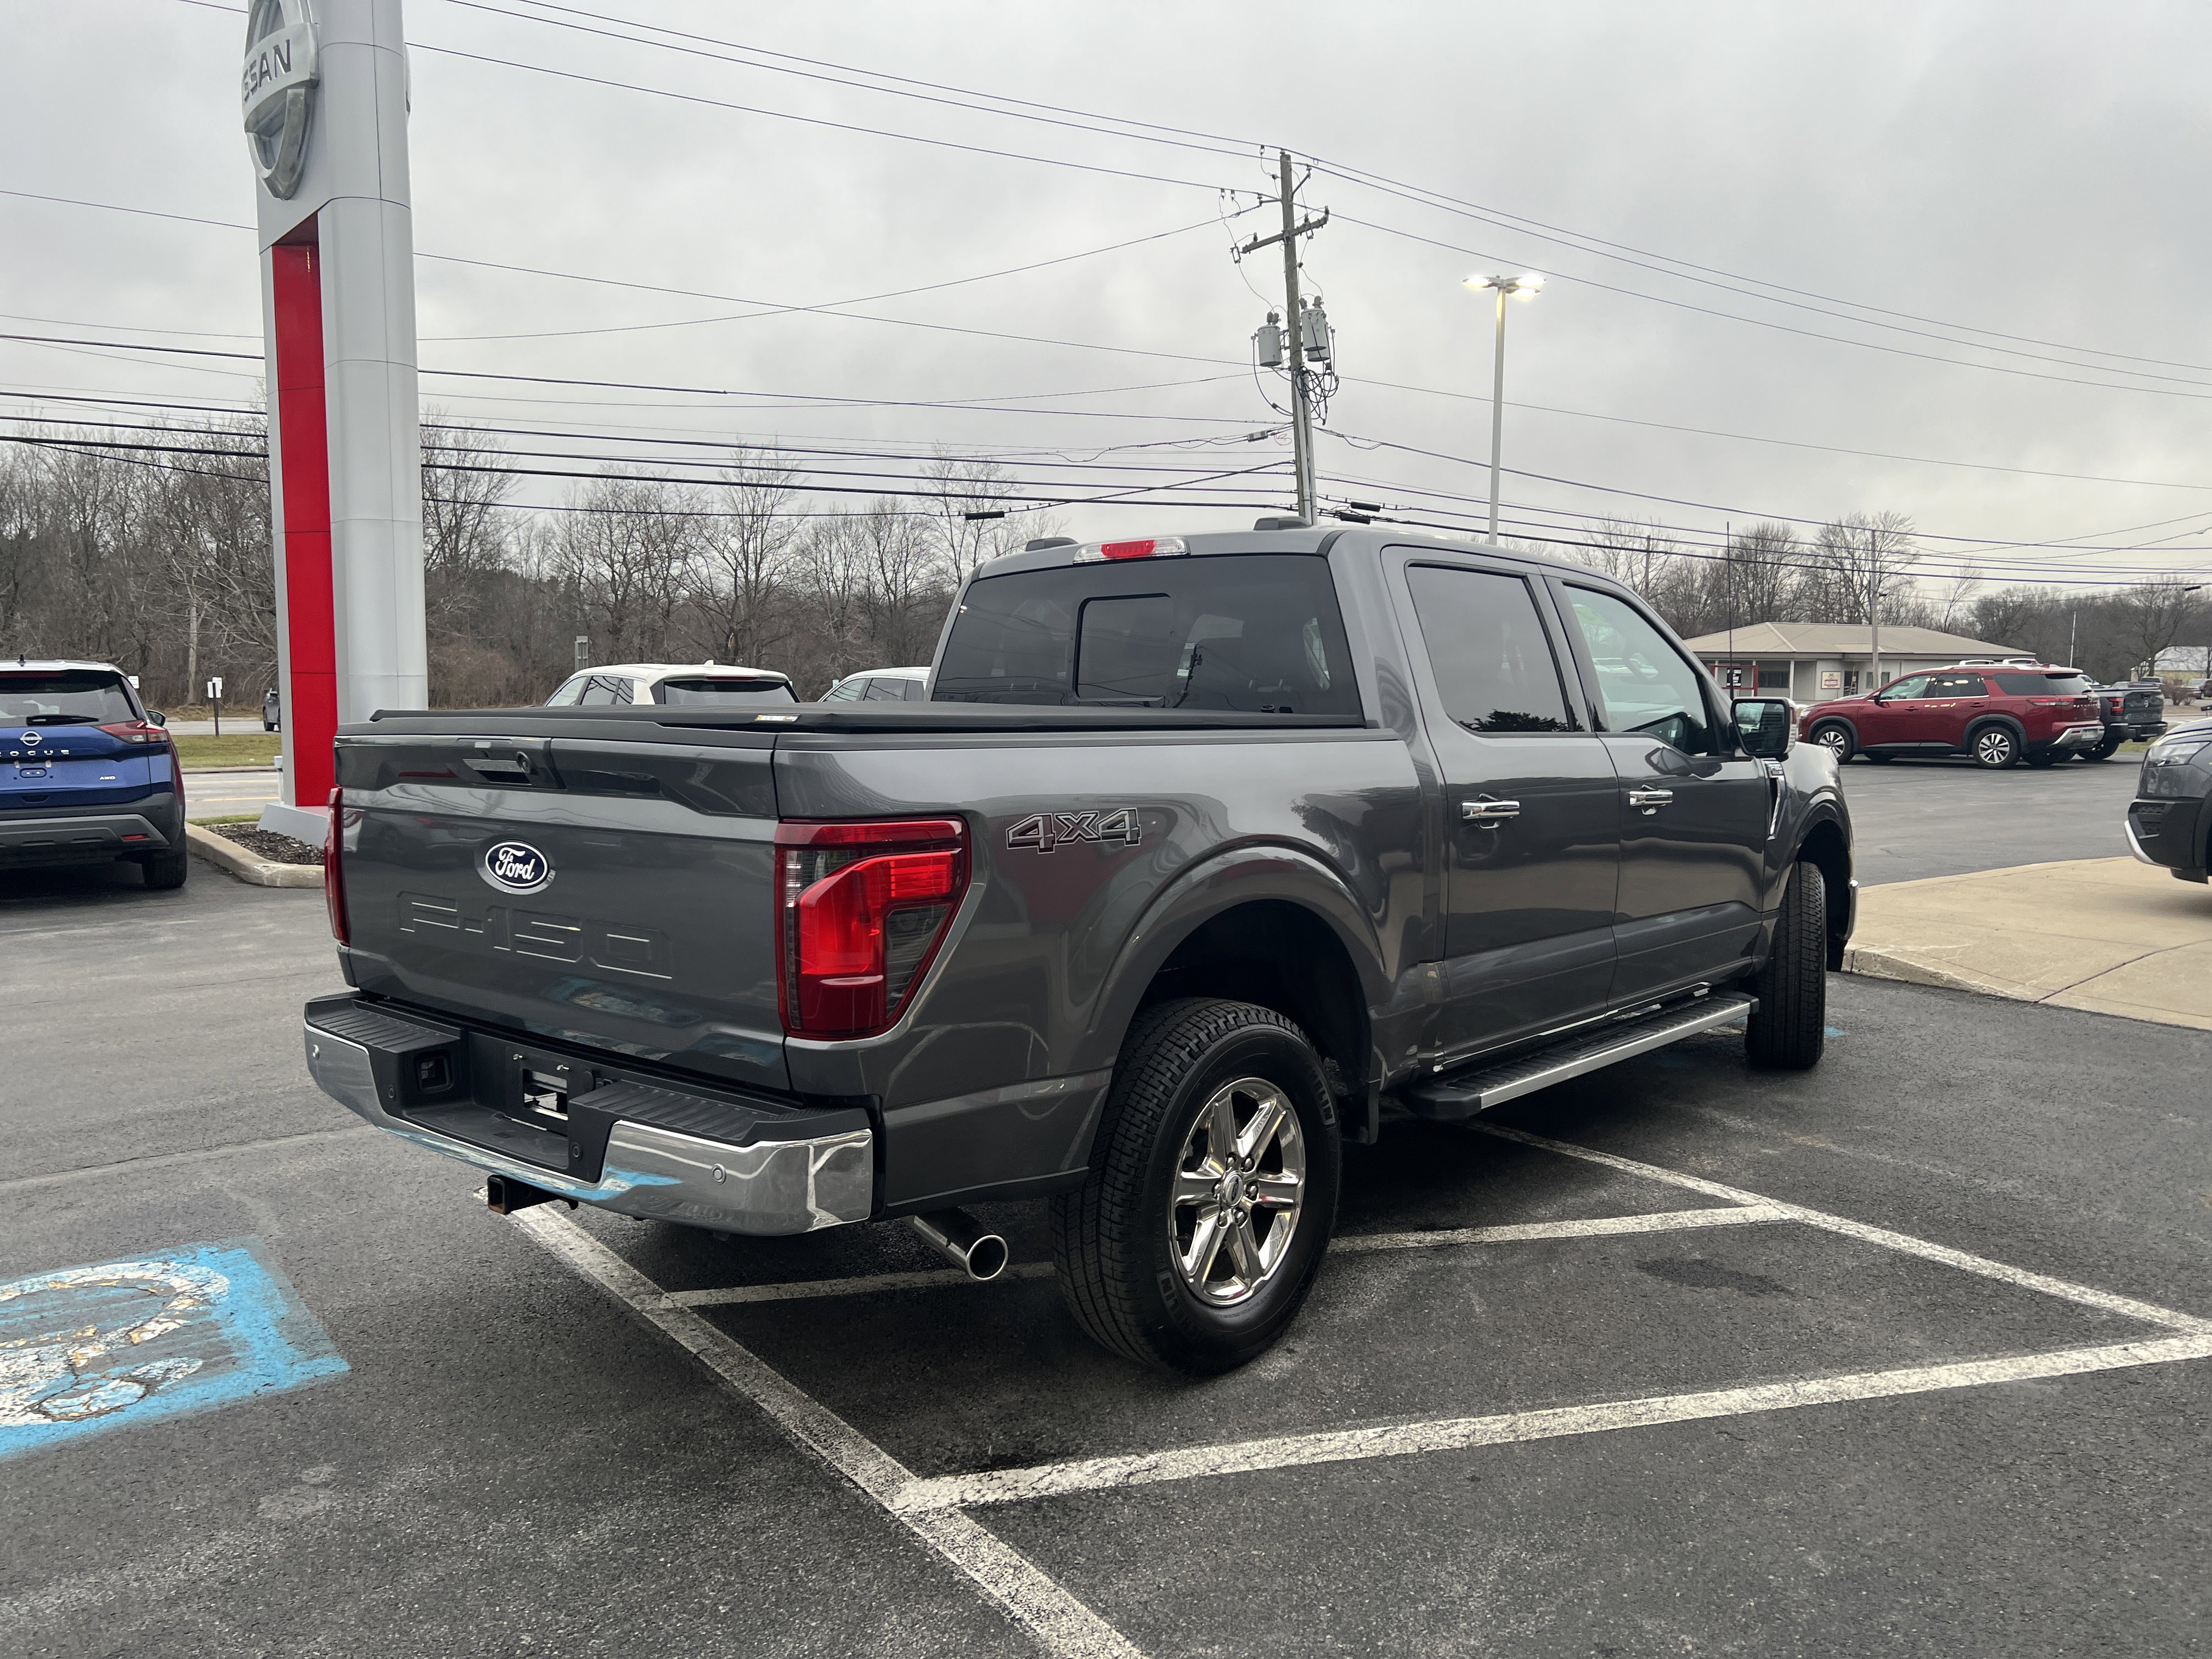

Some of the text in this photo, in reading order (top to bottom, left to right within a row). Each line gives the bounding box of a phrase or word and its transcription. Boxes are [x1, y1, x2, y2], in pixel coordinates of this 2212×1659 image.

[243, 39, 291, 104] SSAN
[495, 847, 535, 880] Ford
[398, 891, 673, 979] F-150
